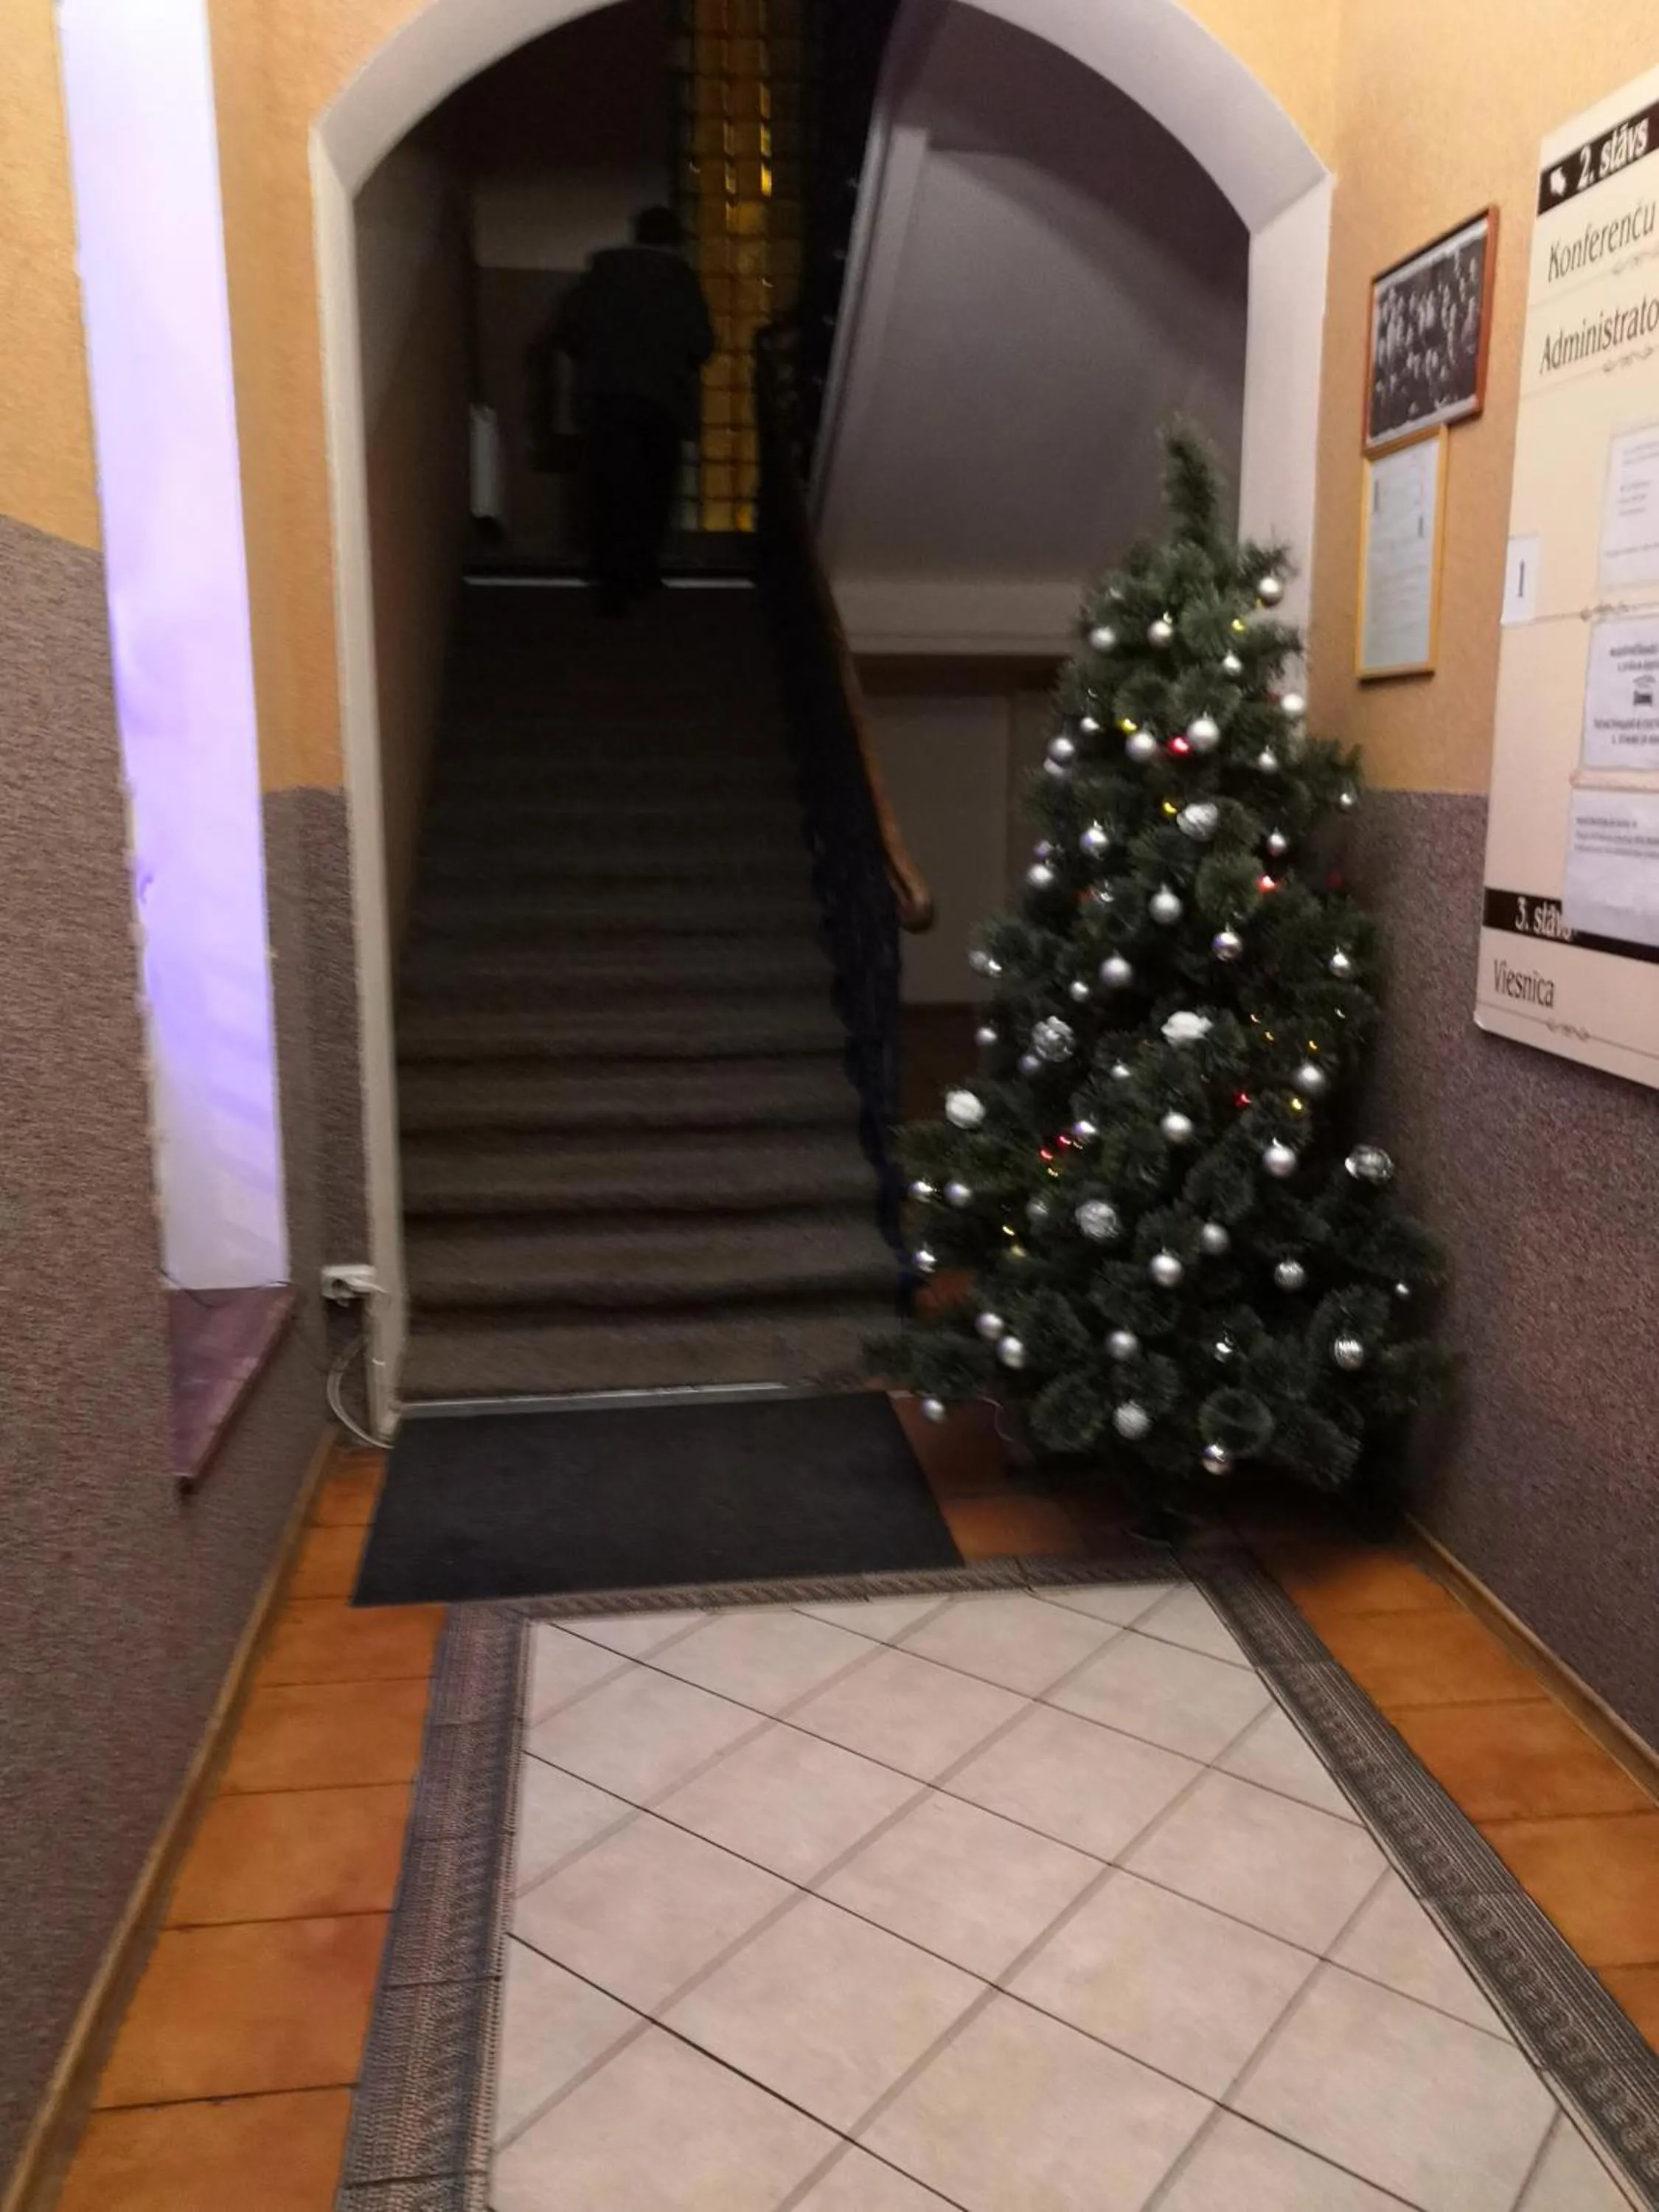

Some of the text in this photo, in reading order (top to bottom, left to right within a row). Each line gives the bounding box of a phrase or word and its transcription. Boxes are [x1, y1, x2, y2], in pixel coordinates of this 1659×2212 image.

[1576, 116, 1649, 191] 2. stāvs
[1539, 294, 1659, 375] Administrato
[1515, 895, 1530, 931] 3.
[1493, 958, 1555, 1009] Viesnīca
